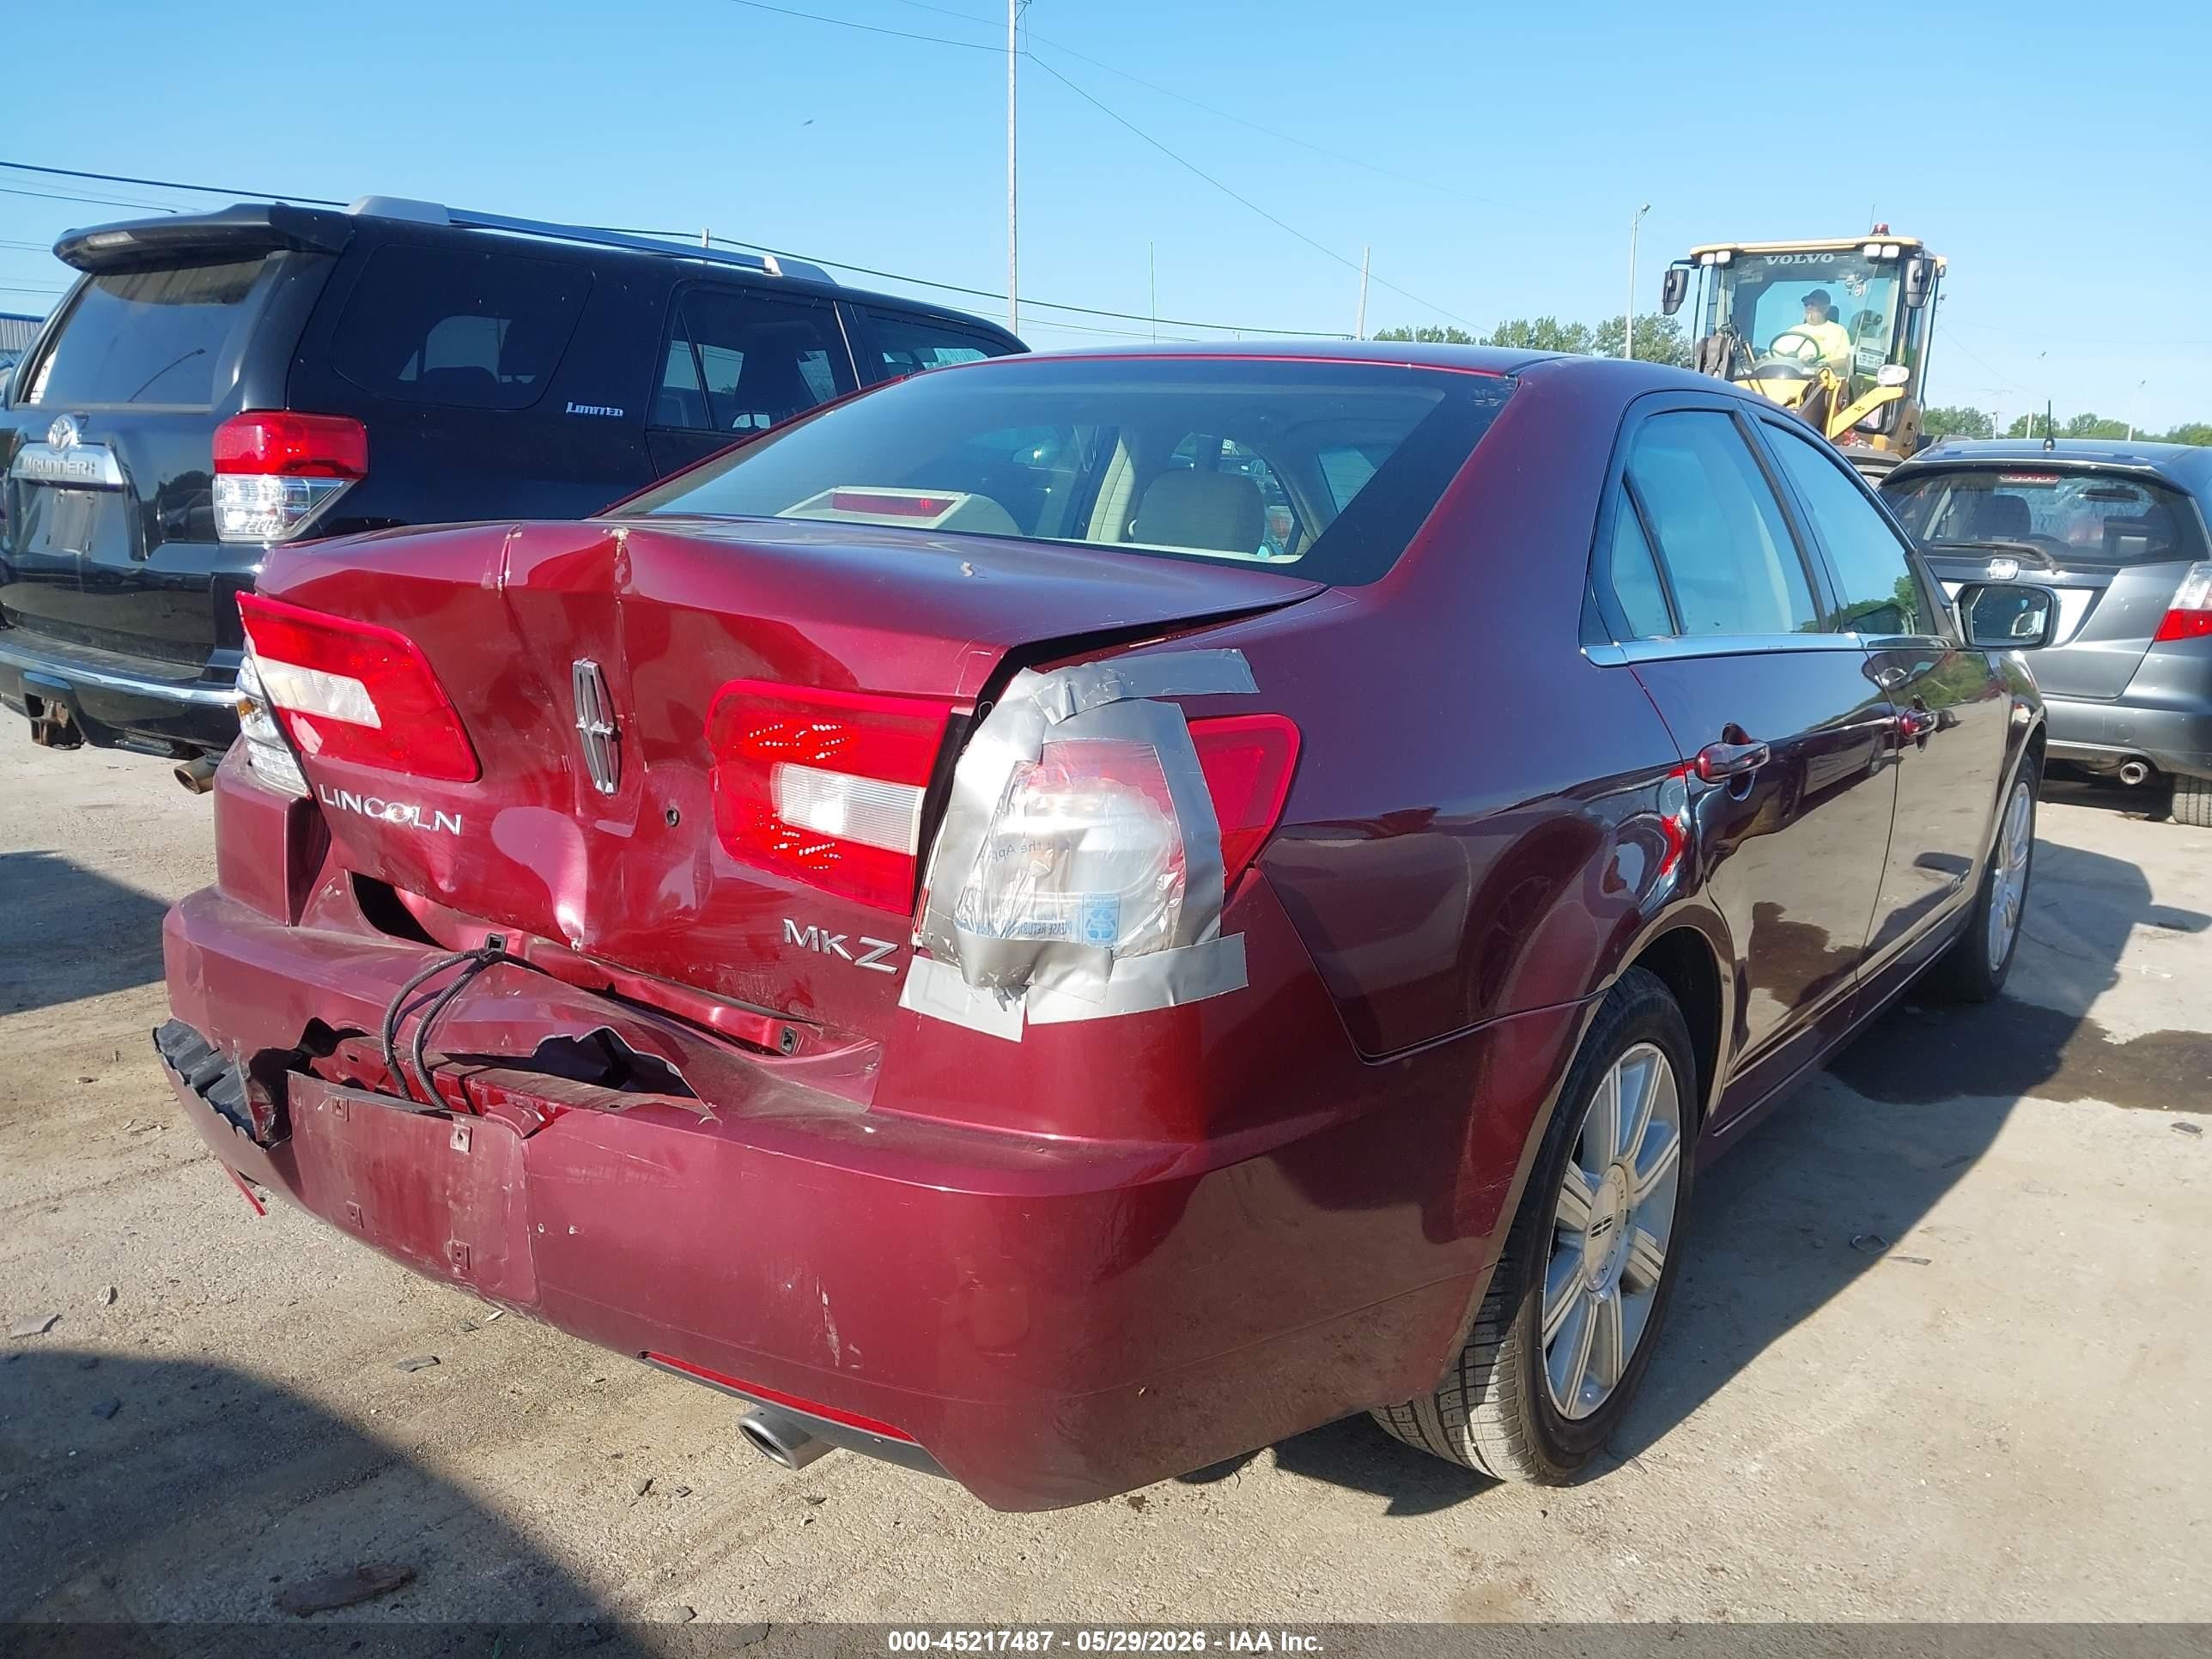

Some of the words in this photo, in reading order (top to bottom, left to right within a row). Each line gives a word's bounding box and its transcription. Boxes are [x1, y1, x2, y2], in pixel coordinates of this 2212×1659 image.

[1764, 253, 1835, 265] VOLVO
[319, 783, 463, 836] LINCOLN
[782, 918, 900, 975] MKZ
